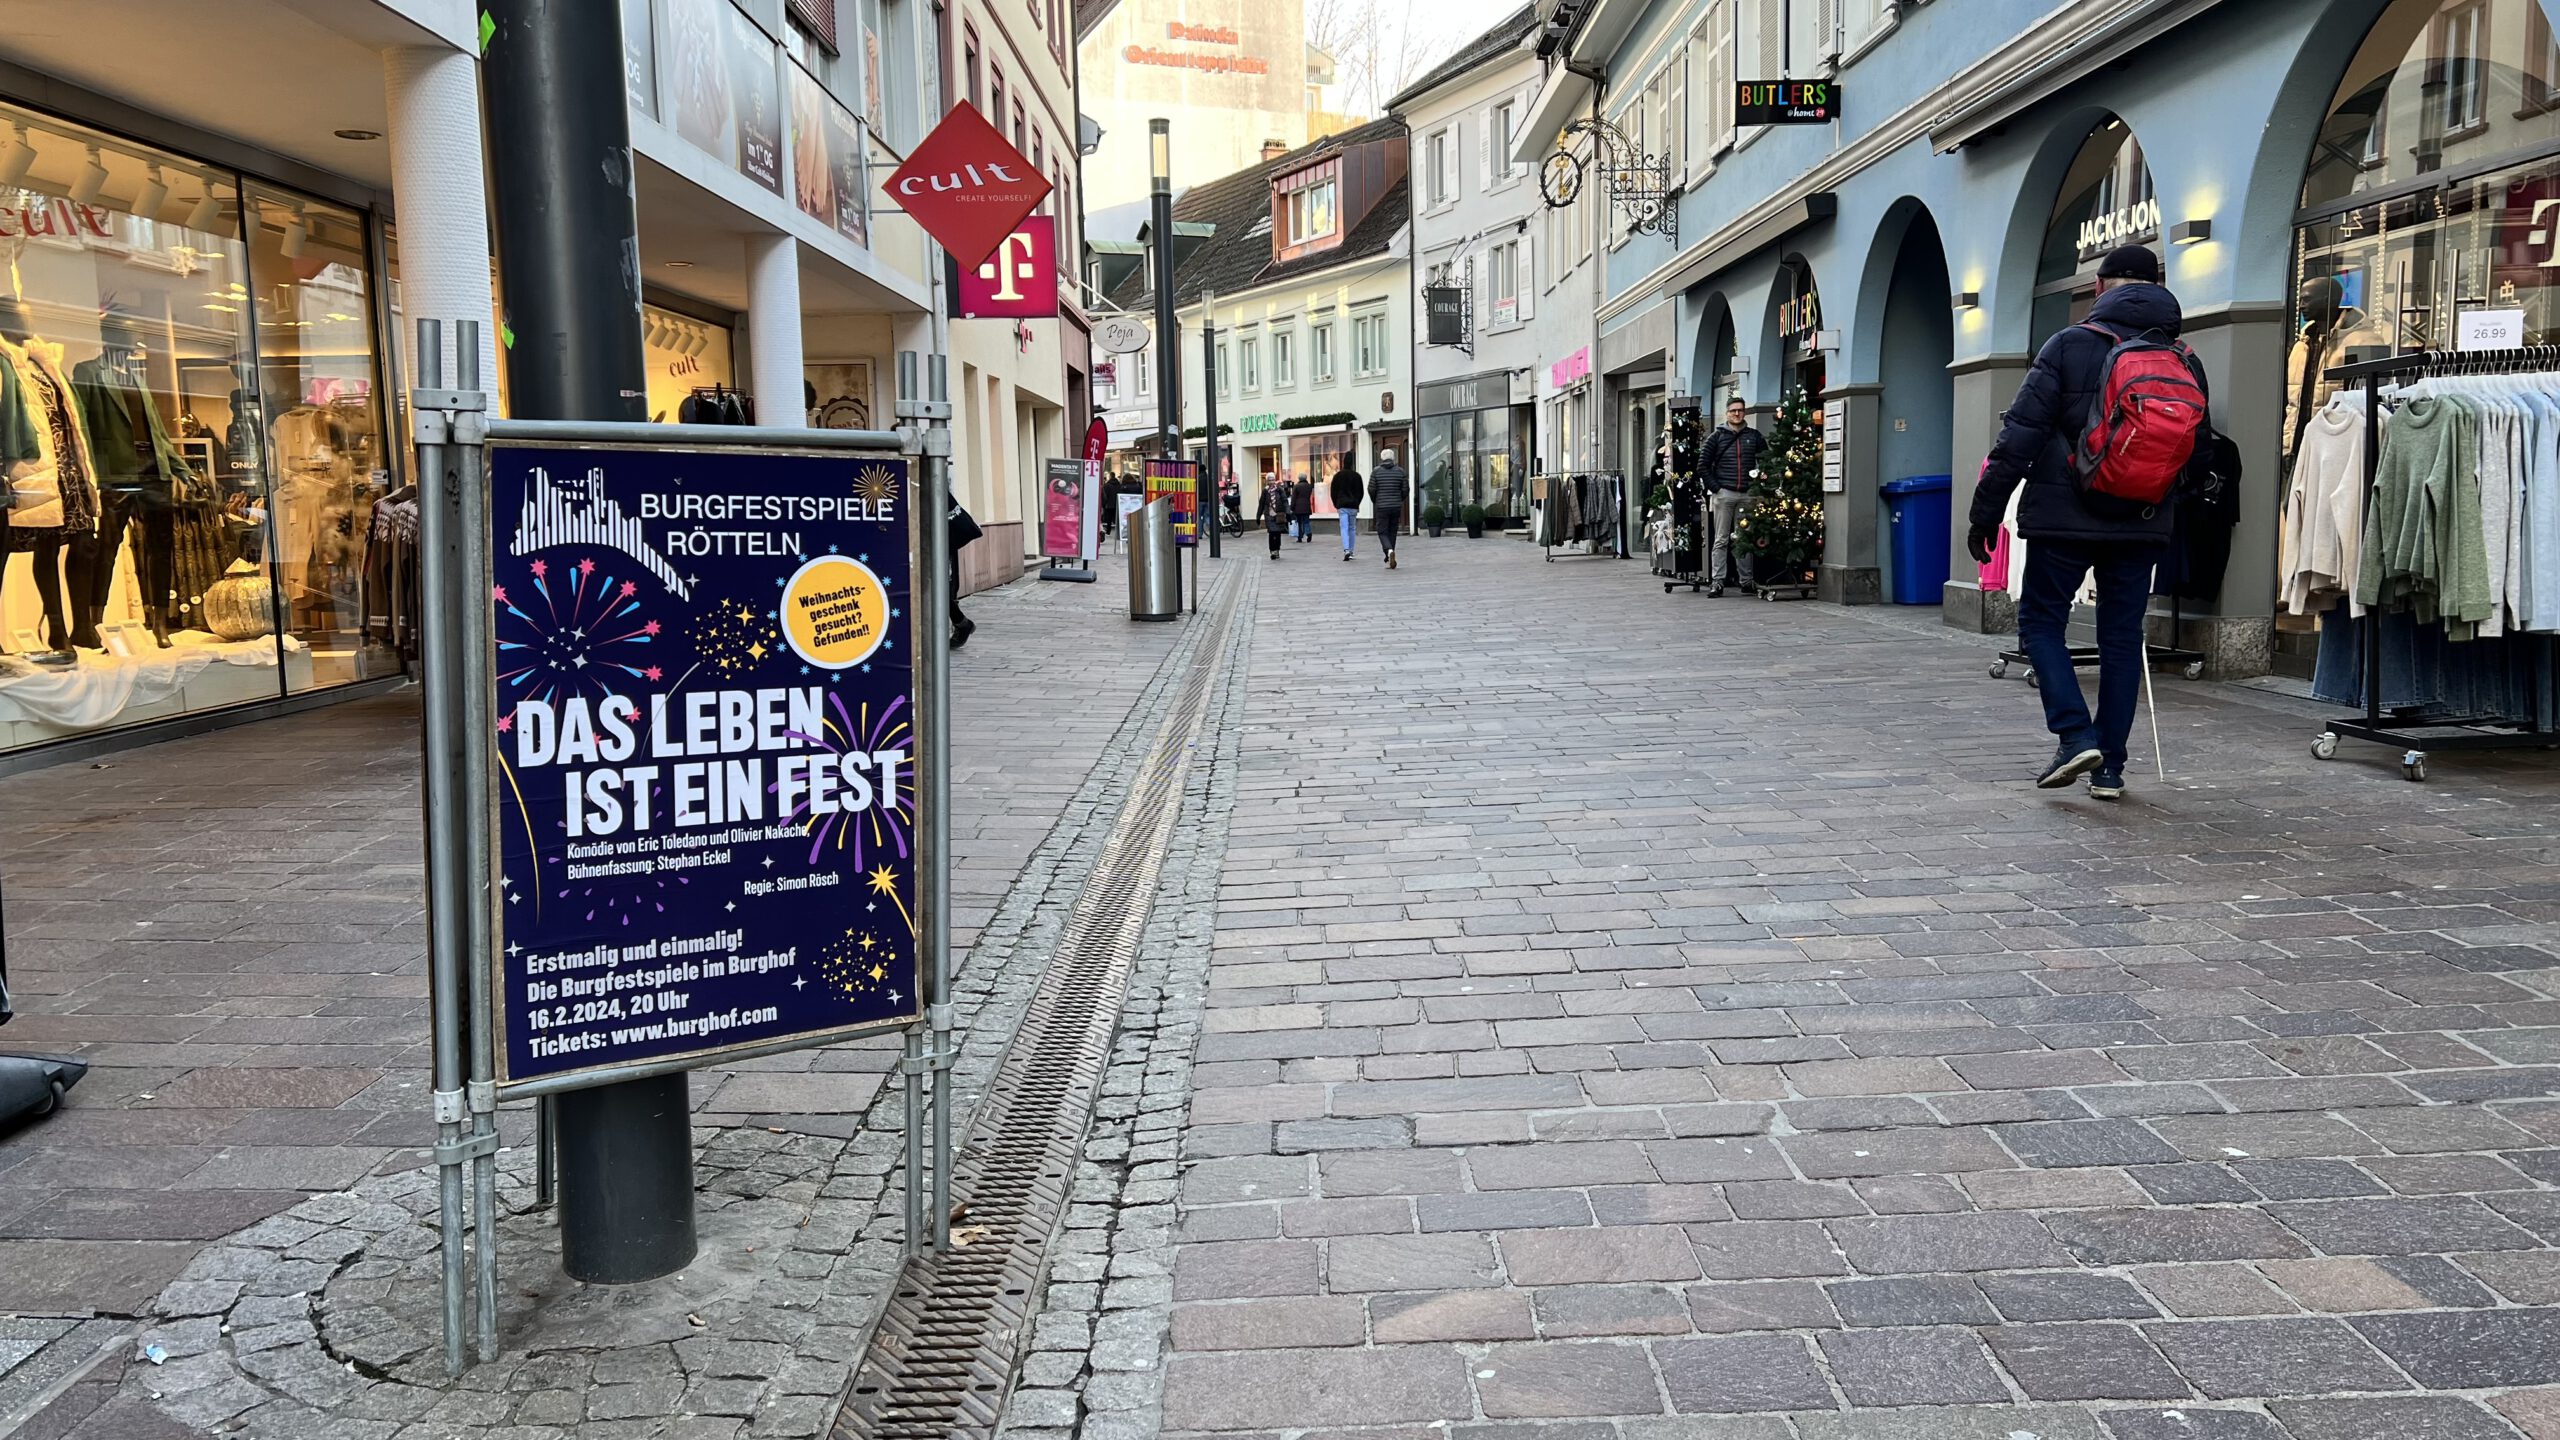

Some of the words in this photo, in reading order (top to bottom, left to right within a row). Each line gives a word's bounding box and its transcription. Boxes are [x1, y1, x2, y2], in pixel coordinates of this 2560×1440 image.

[1741, 84, 1826, 106] BUTLERS
[900, 163, 1021, 195] cult
[955, 194, 985, 202] CREATE
[988, 194, 1032, 202] YOURSELF!
[1434, 302, 1459, 313] COURAGE
[1780, 290, 1817, 337] BUTLERS
[1107, 324, 1134, 346] Peja
[2473, 328, 2507, 339] 26.99
[669, 355, 700, 378] cult
[1449, 383, 1478, 409] COURAGE
[230, 461, 258, 469] ONLY
[641, 493, 894, 522] BURGFESTSPIELE
[667, 526, 800, 556] RÖTTELN
[799, 584, 866, 609] Weihnachts-
[810, 600, 860, 622] geschenk
[814, 611, 862, 635] gesucht?
[813, 623, 870, 648] Gefunden!!
[517, 695, 636, 767] DAS
[651, 686, 823, 758] LEBEN
[565, 766, 658, 837] IST
[674, 759, 762, 827] EIN
[777, 750, 905, 818] FEST
[567, 842, 613, 859] Komödie
[616, 841, 635, 854] von
[638, 836, 659, 852] Eric
[660, 832, 707, 850] Toledano
[709, 831, 728, 846] und
[730, 826, 763, 843] Olivier
[765, 823, 810, 840] Nakache,
[567, 858, 655, 880] Bühnenfassung:
[657, 854, 700, 873] Stephan
[703, 850, 730, 866] Eckel
[744, 877, 775, 897] Regie:
[776, 875, 807, 892] Simon
[809, 871, 839, 888] Rösch
[527, 944, 618, 975] Erstmalig
[622, 940, 657, 962] und
[659, 929, 744, 957] einmalig!
[527, 981, 558, 1002] Die
[561, 961, 699, 996] Burgfestspiele
[702, 957, 725, 979] im
[728, 947, 797, 974] Burghof
[528, 999, 627, 1030] 16.2.2024,
[630, 997, 655, 1015] 20
[657, 990, 690, 1012] Uhr
[529, 1033, 607, 1058] Tickets:
[611, 1003, 778, 1046] www.burghof.com
